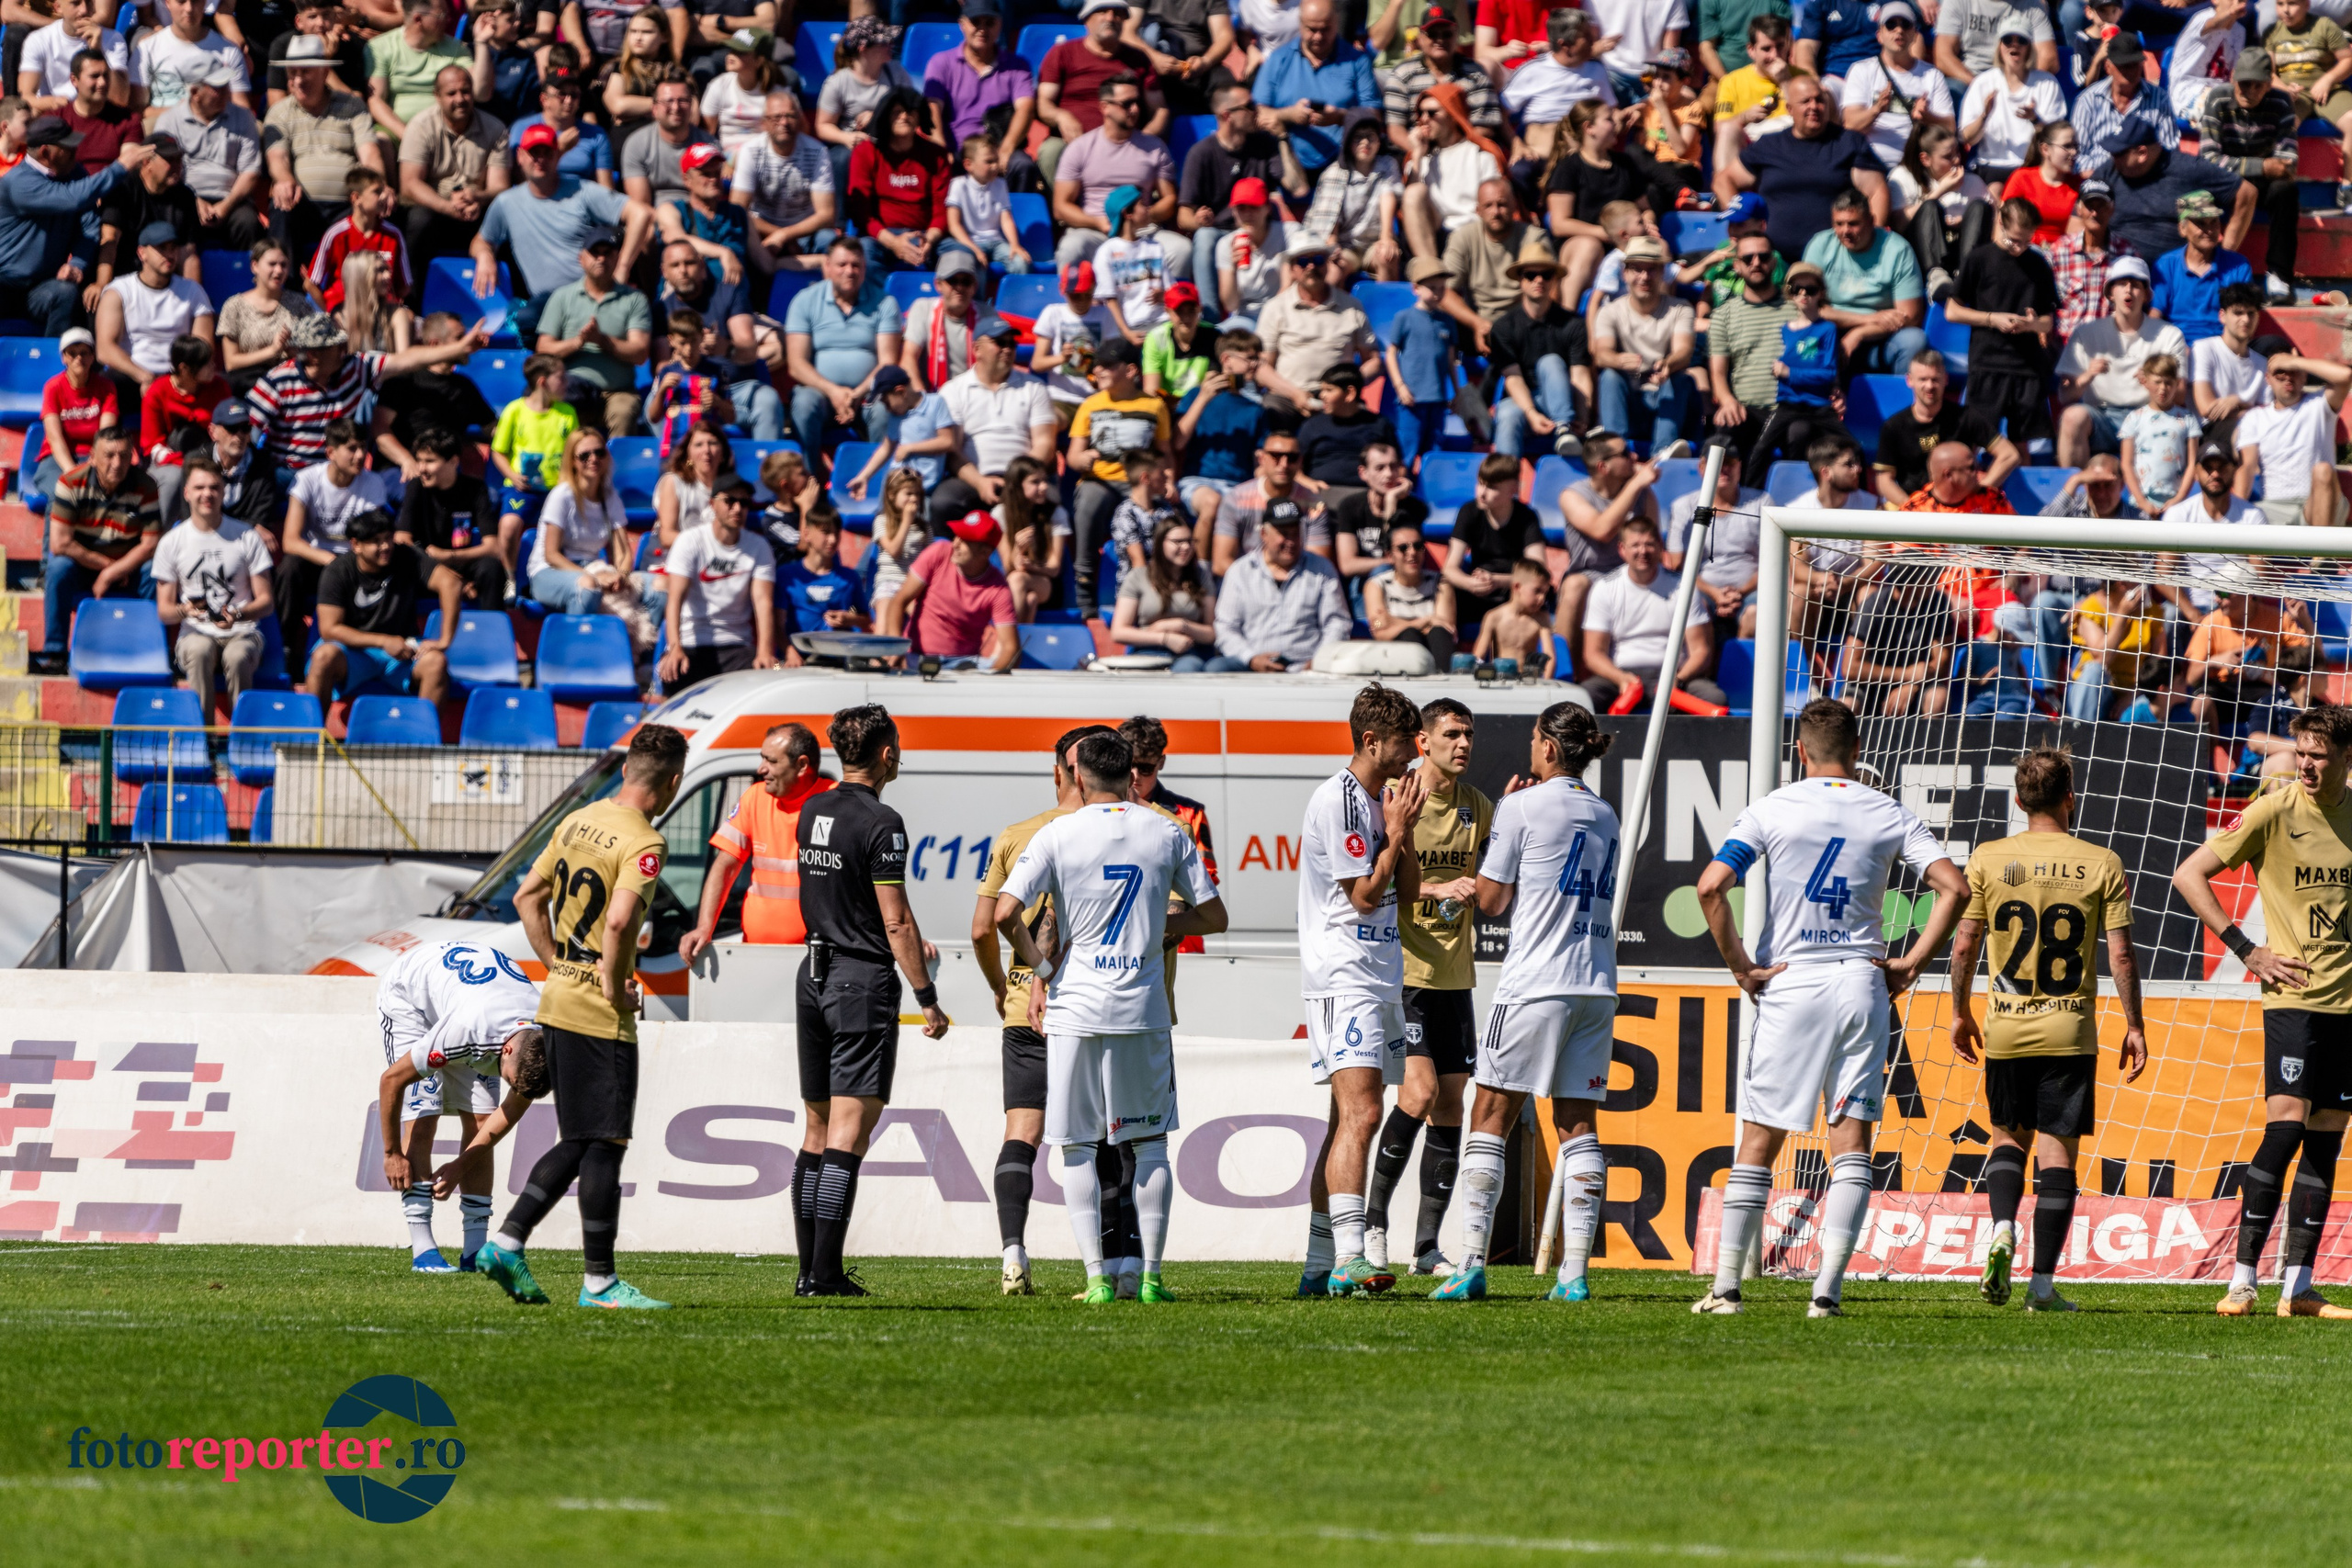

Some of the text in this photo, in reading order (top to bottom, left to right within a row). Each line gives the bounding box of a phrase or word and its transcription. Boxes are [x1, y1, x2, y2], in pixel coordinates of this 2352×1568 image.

[576, 824, 617, 850] HILS
[798, 848, 842, 870] NORDIS
[1416, 851, 1473, 867] MAXBET
[1559, 831, 1617, 912] 44
[1805, 837, 1851, 919] 4
[2034, 862, 2086, 880] HILS
[2033, 880, 2085, 890] DEVELOPMENT
[1101, 864, 1143, 945] 7
[1801, 929, 1850, 943] MIRON
[1993, 900, 2086, 998] 28
[1094, 955, 1146, 970] MAILAT
[1345, 1017, 1363, 1046] 6
[1353, 1049, 1378, 1058] Vestra
[1121, 1115, 1147, 1125] Smart
[356, 1099, 1329, 1209] ELSAO
